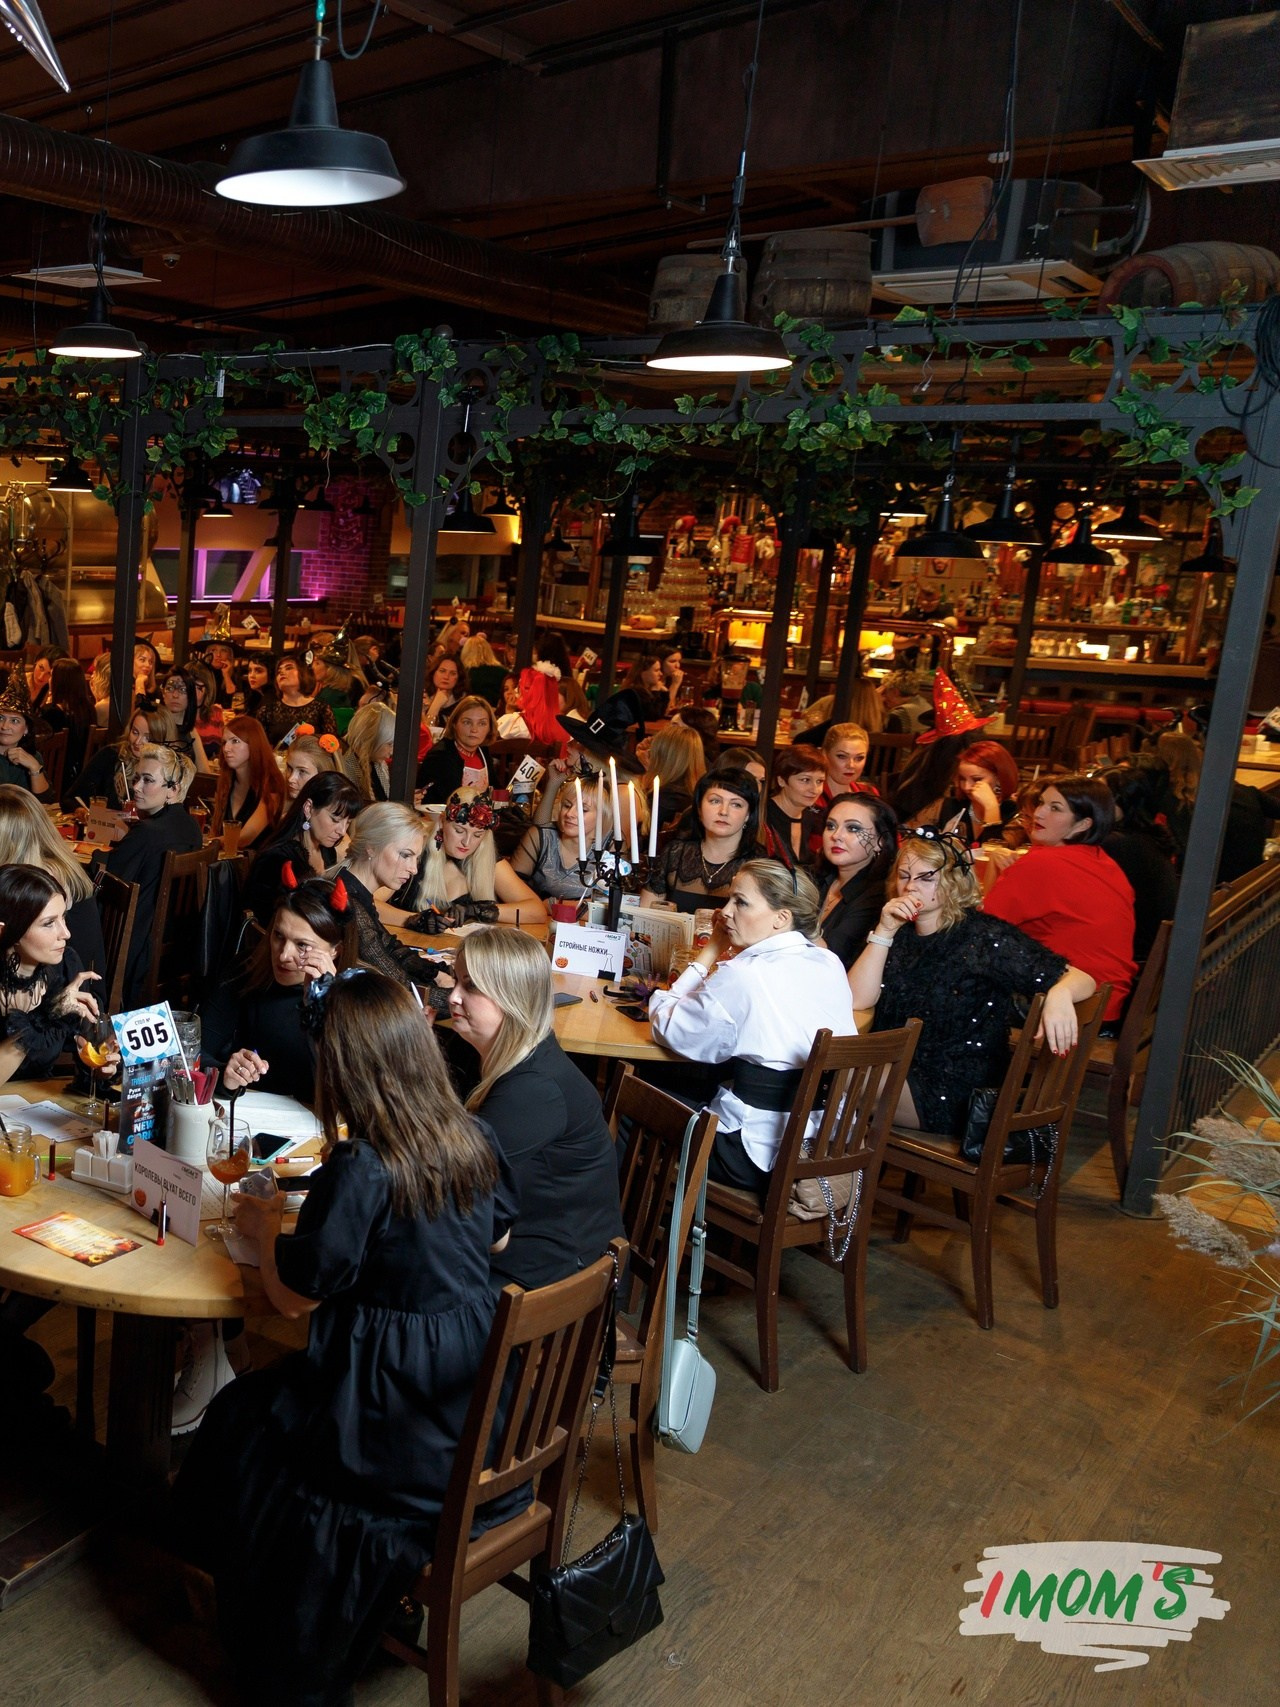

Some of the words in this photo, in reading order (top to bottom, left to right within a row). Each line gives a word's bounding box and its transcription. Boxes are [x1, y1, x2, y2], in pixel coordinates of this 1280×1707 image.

[520, 762, 540, 780] 404
[559, 940, 588, 952] СТРОЙНЫЕ
[588, 946, 608, 956] НОЖКИ
[127, 1022, 168, 1050] 505
[133, 1118, 156, 1133] NEW
[135, 1162, 162, 1185] КОРОЛЕВЫ
